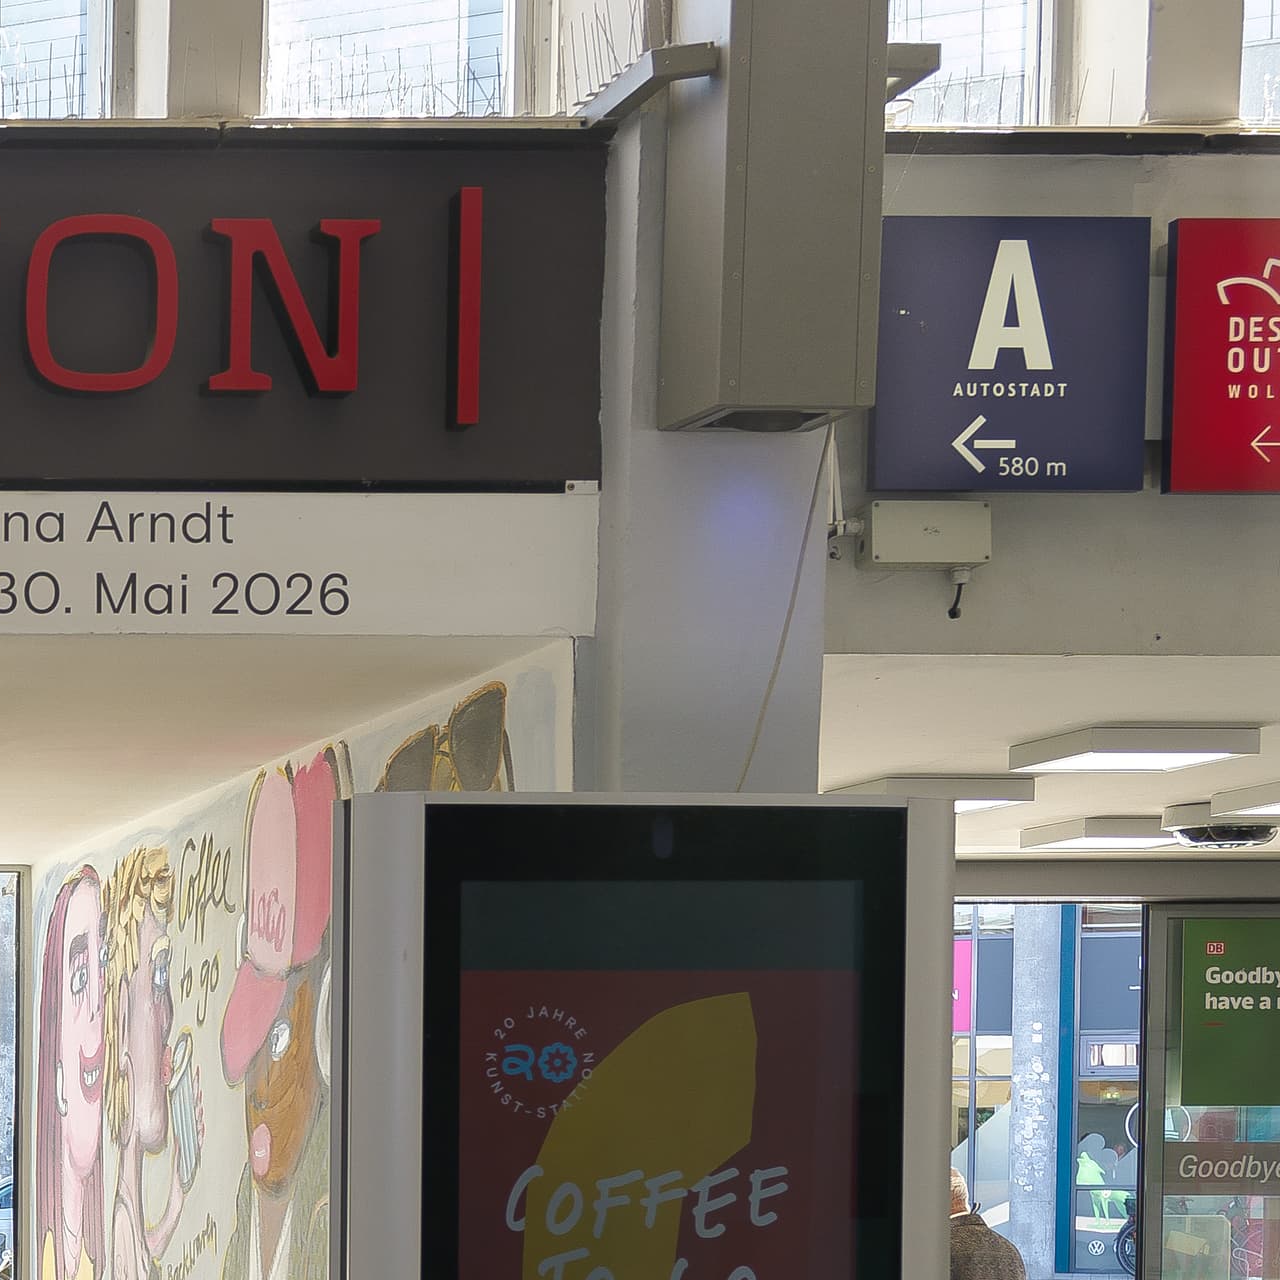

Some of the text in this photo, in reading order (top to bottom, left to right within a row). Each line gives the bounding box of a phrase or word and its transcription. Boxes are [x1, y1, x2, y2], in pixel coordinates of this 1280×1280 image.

[967, 239, 1054, 370] A
[953, 382, 1068, 397] AUTOSTADT
[998, 457, 1067, 476] 580 m
[85, 499, 235, 544] Arndt
[95, 571, 189, 616] Mai
[210, 571, 351, 616] 2026
[1207, 943, 1224, 954] DB
[1204, 991, 1272, 1010] have a
[526, 1005, 589, 1041] JAHRE
[504, 1163, 790, 1240] COFFEE
